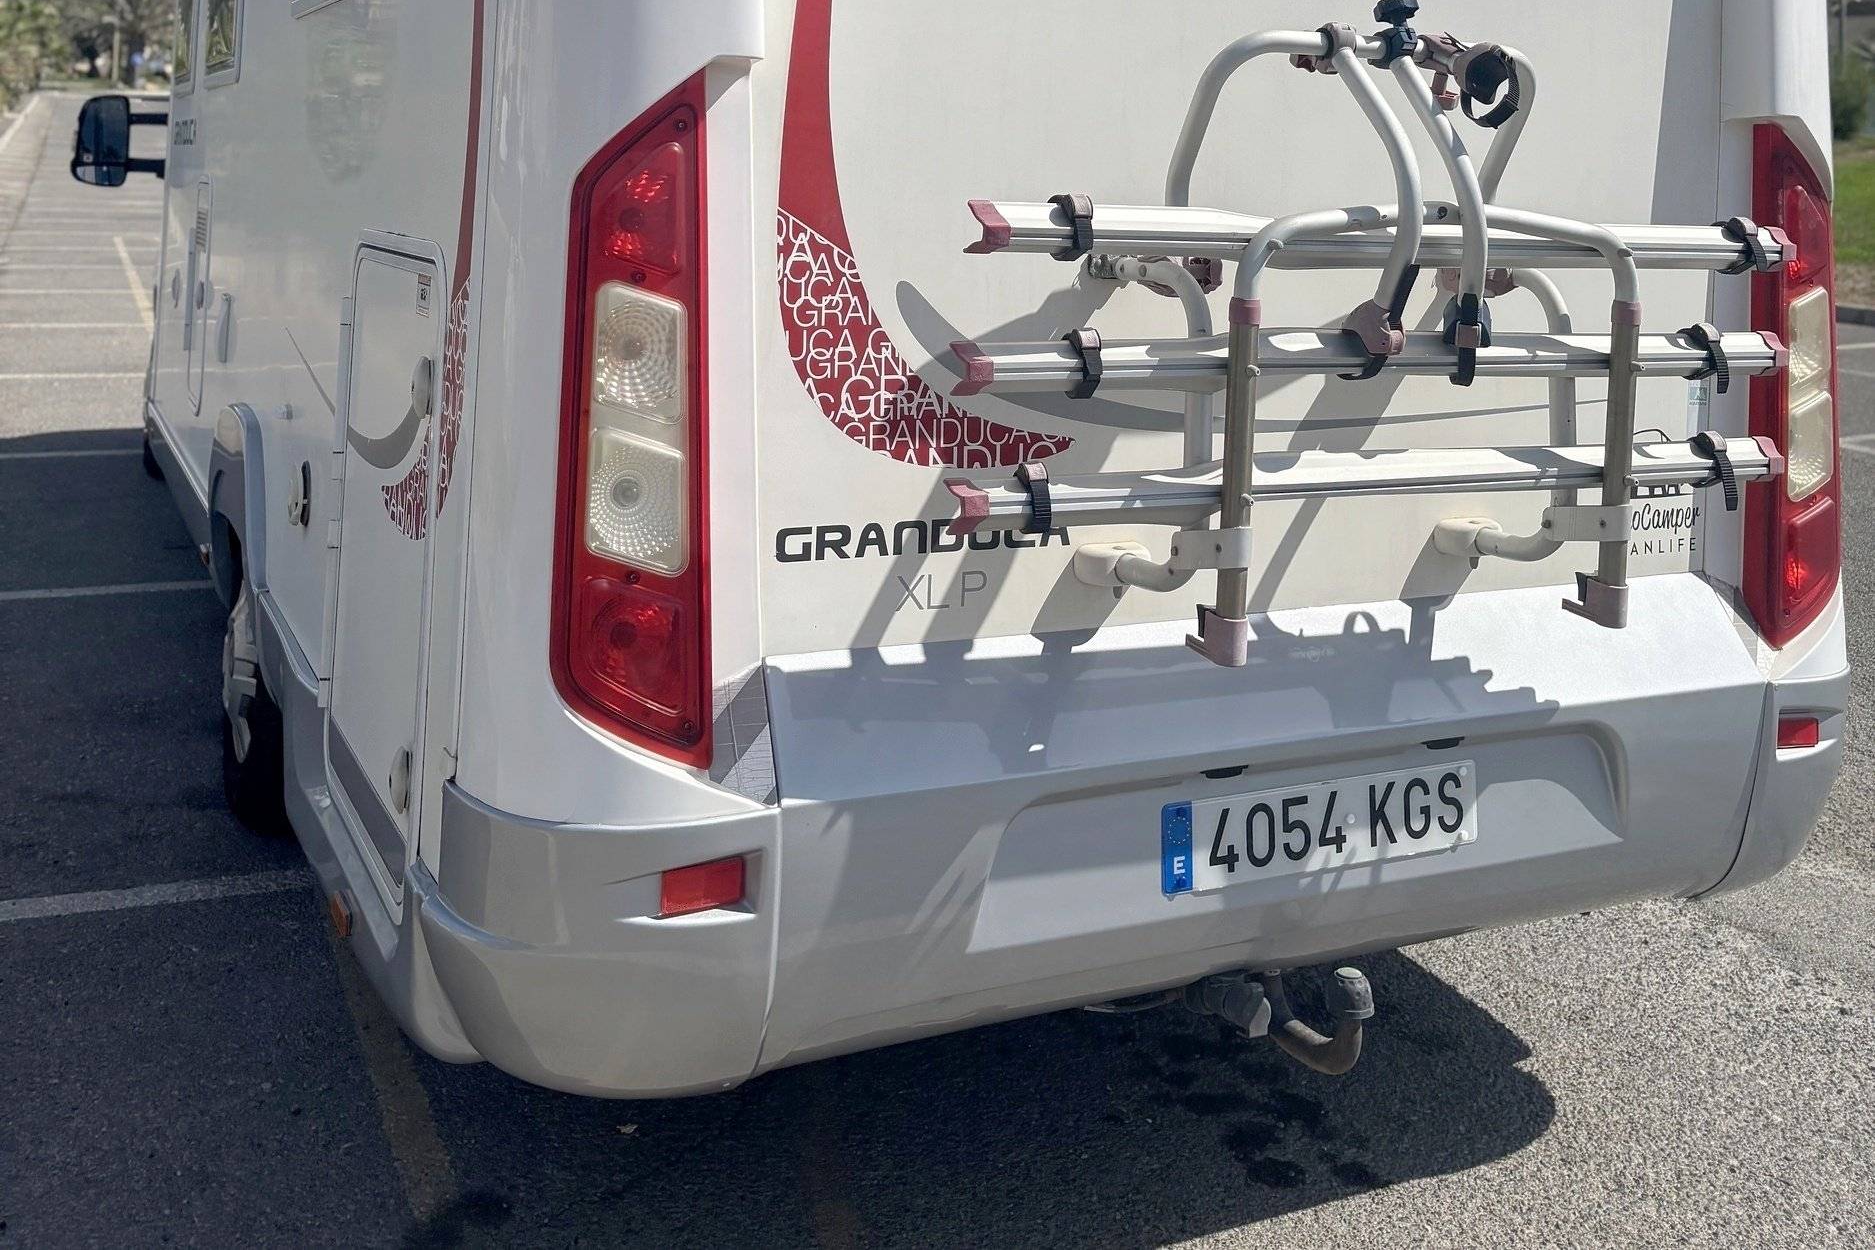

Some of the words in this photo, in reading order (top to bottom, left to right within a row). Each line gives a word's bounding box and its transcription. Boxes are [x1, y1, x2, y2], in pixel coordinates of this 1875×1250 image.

[1631, 502, 1701, 535] oCamper
[1629, 536, 1697, 556] ANLIFE
[895, 573, 950, 612] XL
[959, 570, 988, 608] P
[1208, 790, 1348, 874] 4054
[1368, 771, 1464, 848] KGS
[1172, 854, 1186, 875] E
